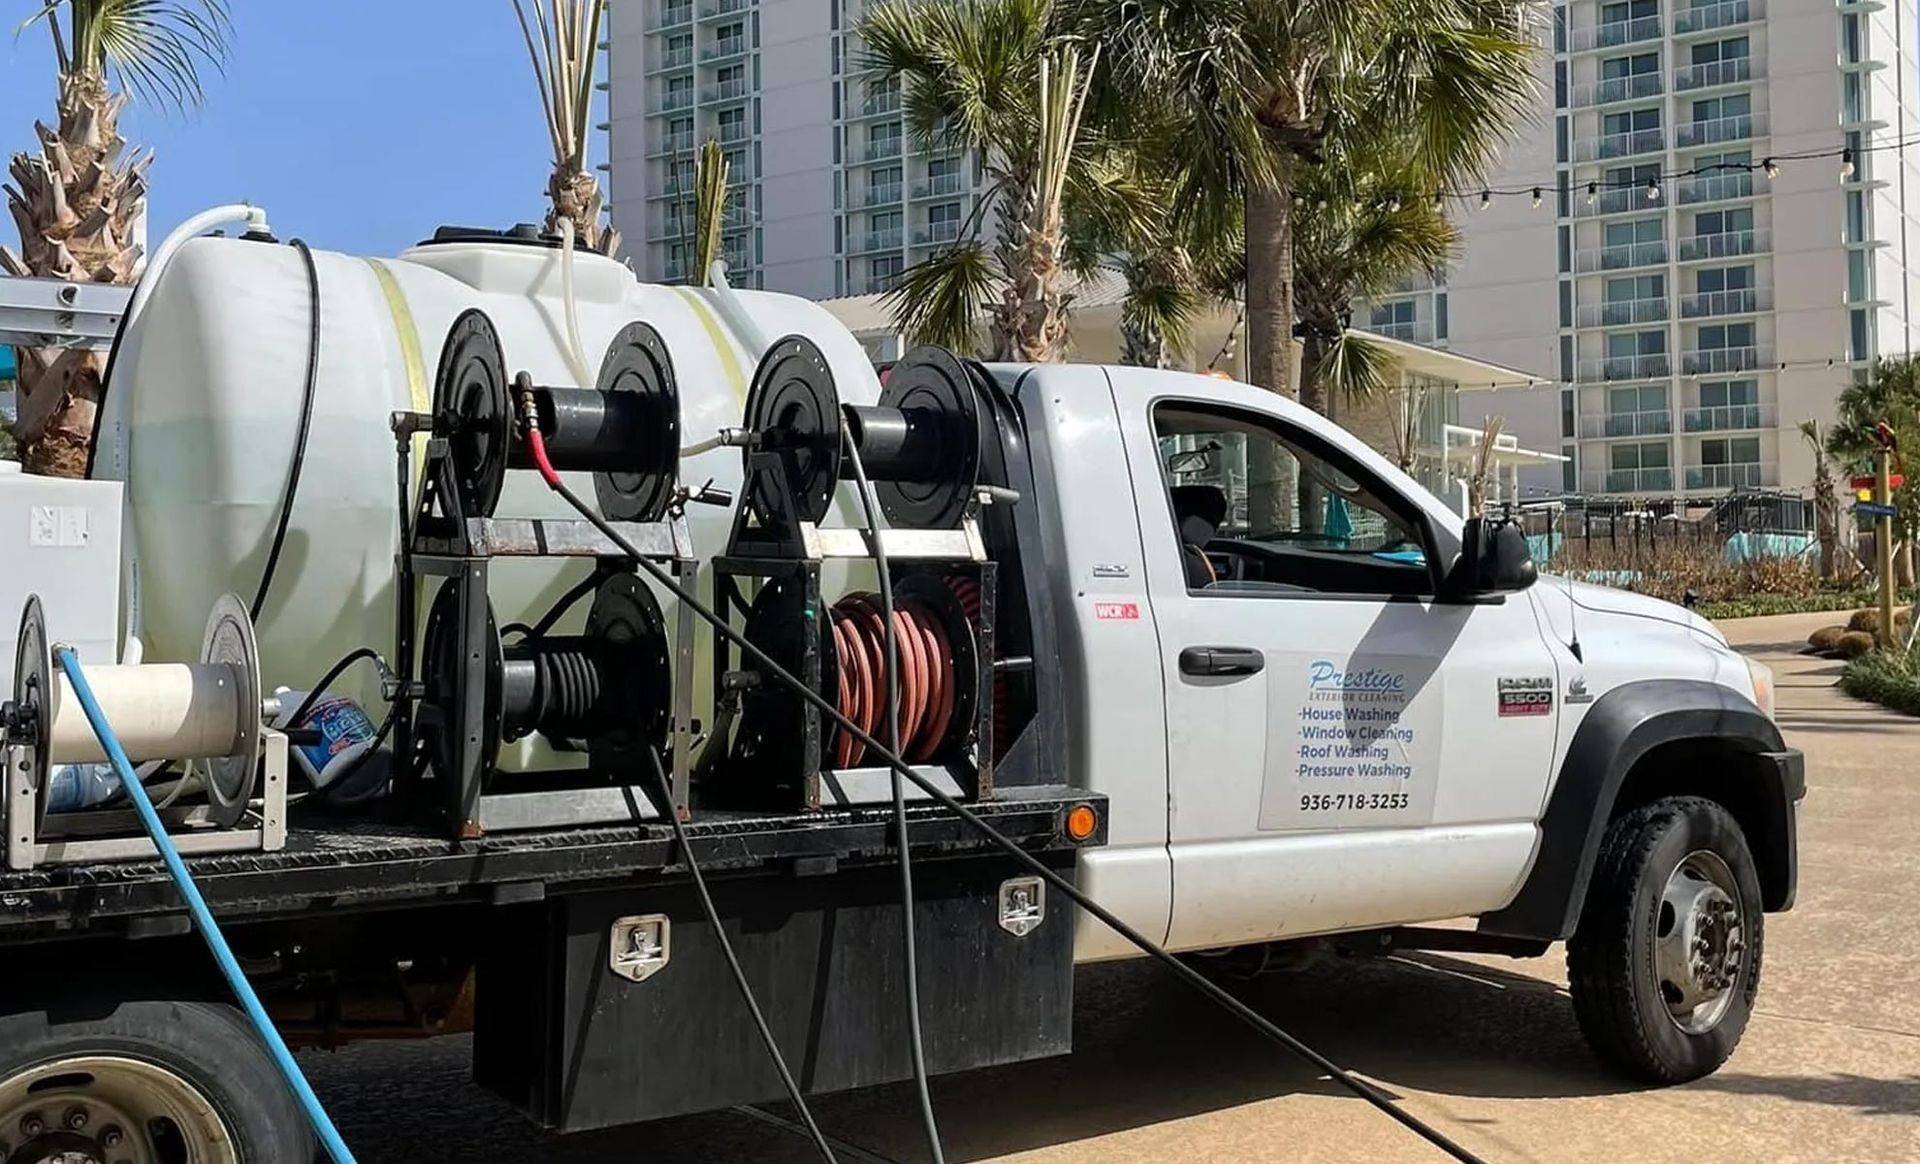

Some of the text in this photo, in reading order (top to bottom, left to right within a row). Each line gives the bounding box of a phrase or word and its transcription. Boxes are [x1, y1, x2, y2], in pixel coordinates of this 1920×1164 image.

[1310, 661, 1404, 695] Prestige
[1309, 692, 1406, 703] EXTERIOR CLEANING
[1504, 693, 1550, 704] 5500
[1344, 707, 1400, 724] Washing
[1358, 726, 1413, 743] Cleaning
[1335, 745, 1389, 761] Washing
[1357, 763, 1412, 779] Washing
[1300, 794, 1409, 811] 936-718-3253
